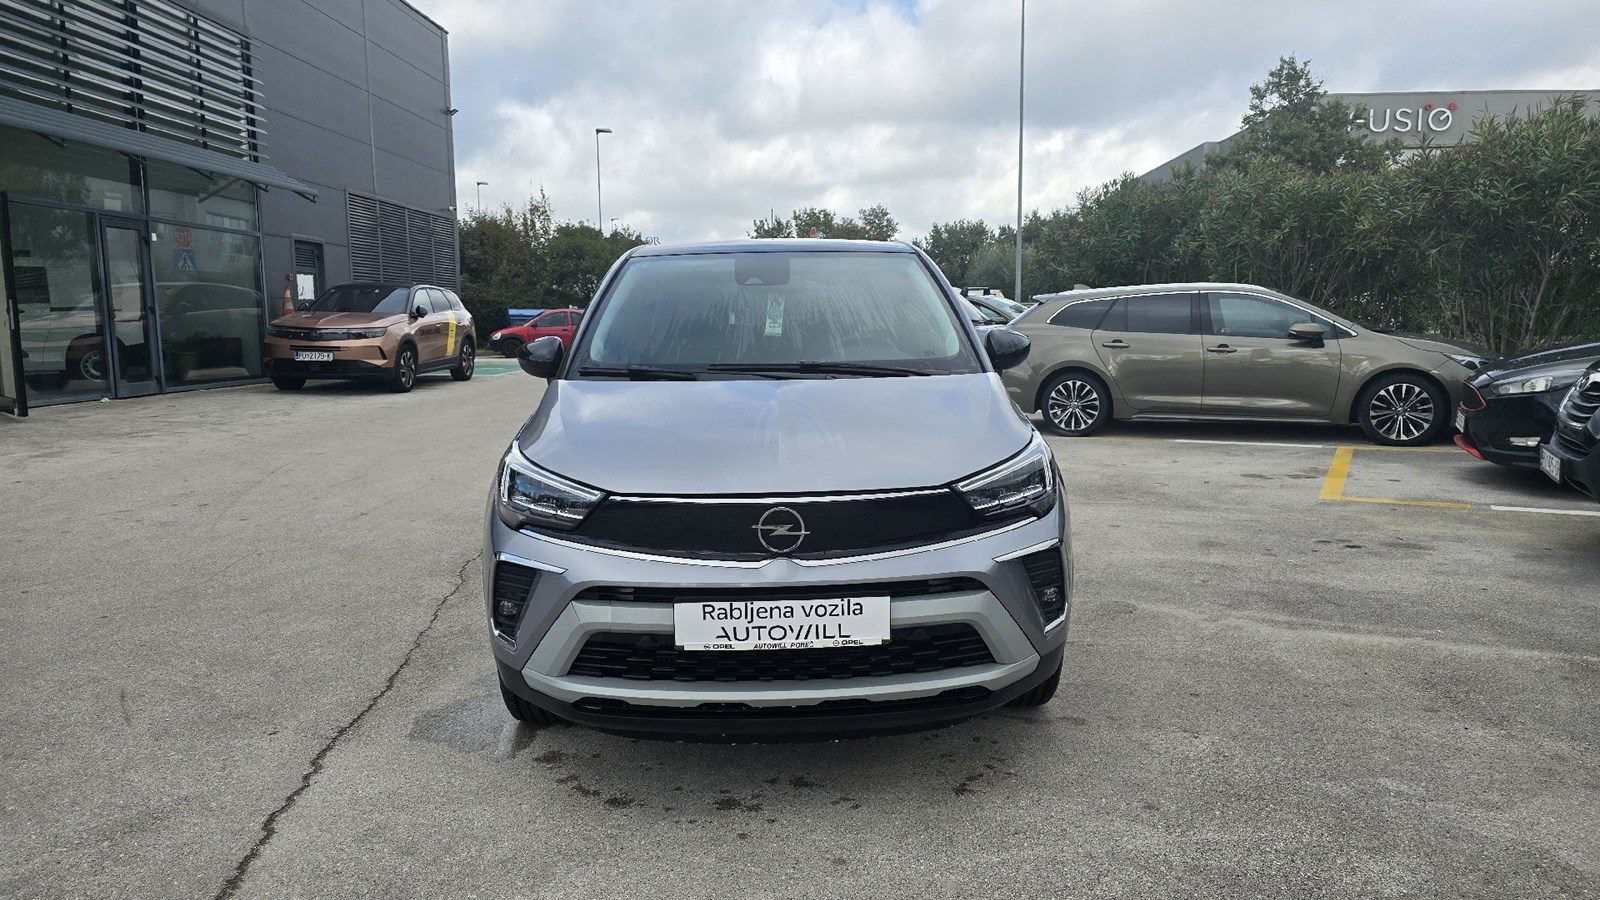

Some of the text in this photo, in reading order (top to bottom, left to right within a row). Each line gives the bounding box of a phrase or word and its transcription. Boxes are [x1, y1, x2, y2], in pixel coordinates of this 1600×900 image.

[702, 598, 864, 623] Rabljena vozila
[716, 623, 851, 642] AUTOWILL
